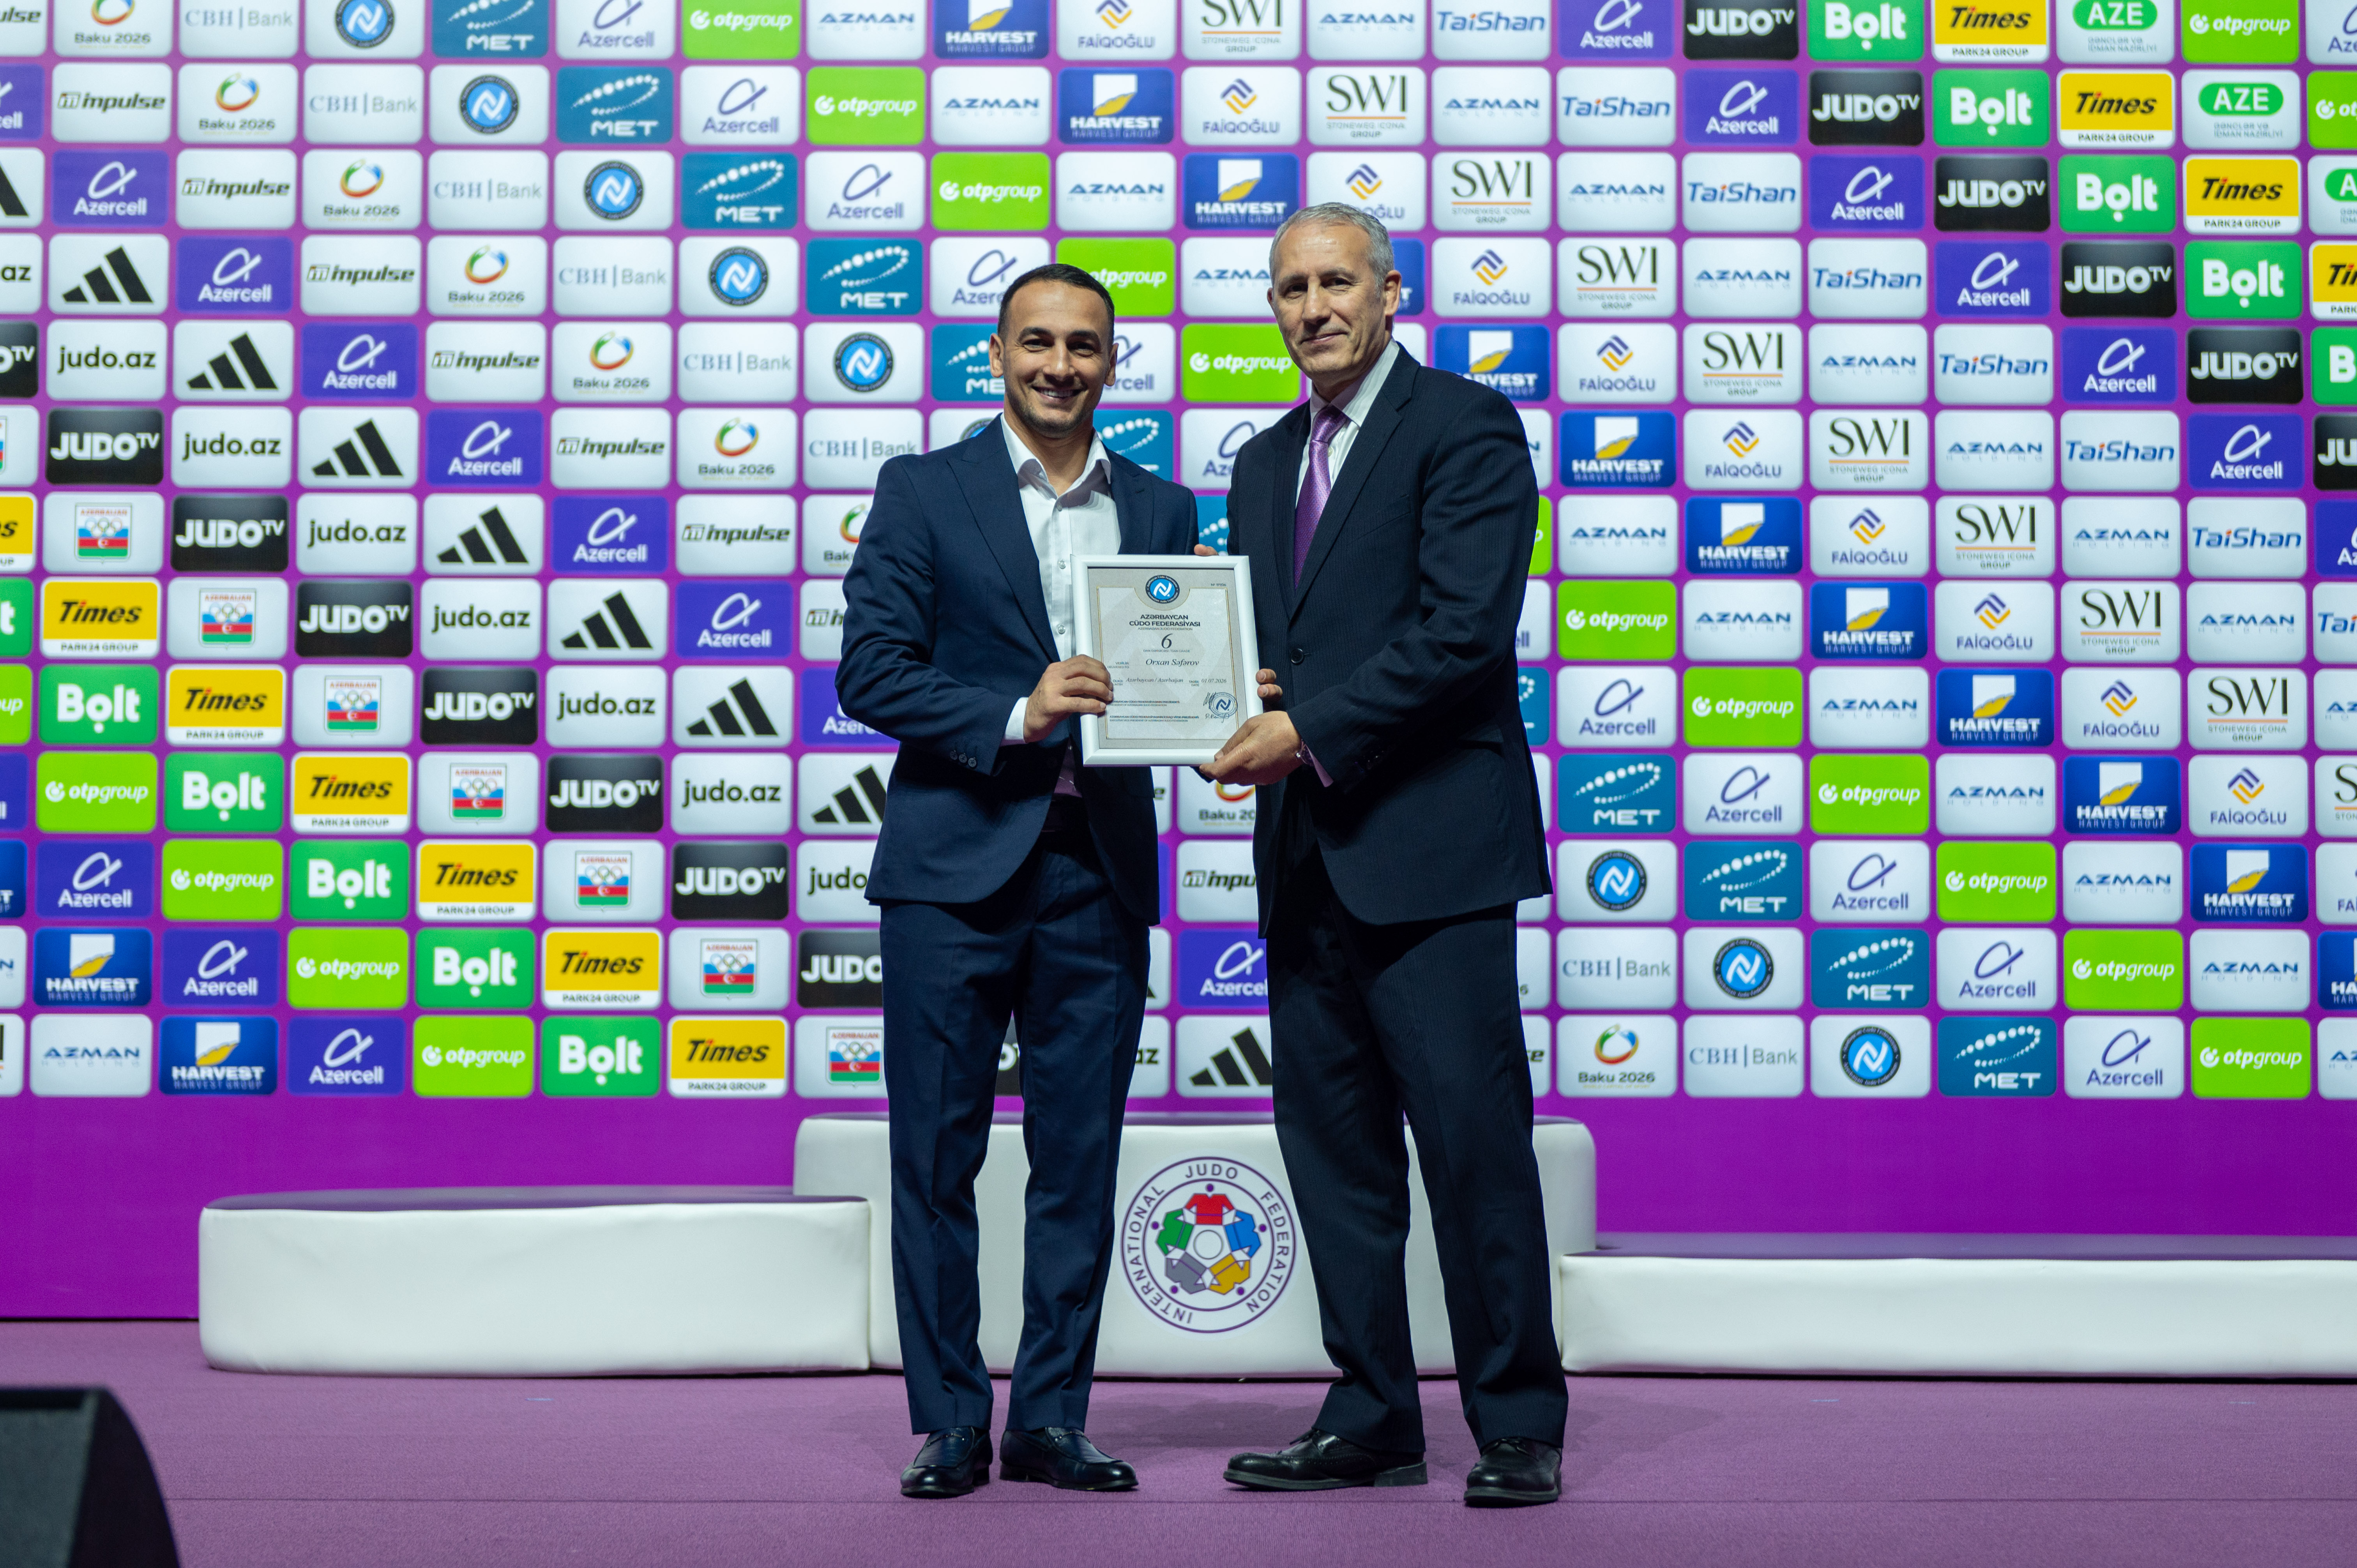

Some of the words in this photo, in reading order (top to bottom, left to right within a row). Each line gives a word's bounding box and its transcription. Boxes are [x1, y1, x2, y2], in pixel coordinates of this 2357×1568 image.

[184, 9, 231, 25] CBH
[248, 9, 292, 25] Bank
[713, 11, 791, 30] otpgroup
[1320, 13, 1413, 23] AZMAN
[1436, 11, 1544, 30] TaiShan
[2212, 15, 2288, 34] otpgroup
[74, 32, 110, 42] Baku
[115, 33, 150, 42] 2026
[466, 34, 534, 49] MET
[577, 30, 654, 46] Azercell
[1580, 30, 1652, 48] Azercell
[82, 93, 166, 112] impulse
[1326, 76, 1406, 112] SWI
[2214, 88, 2268, 111] AZE
[1951, 87, 2031, 135] Bolt
[702, 117, 779, 132] Azercell
[207, 179, 290, 199] impulse
[963, 182, 1041, 201] otpgroup
[1070, 184, 1164, 194] AZMAN
[1688, 183, 1795, 202] TaiShan
[2203, 178, 2282, 200] Times
[716, 207, 783, 222] MET
[331, 266, 415, 285] impulse
[558, 268, 606, 284] CBH
[622, 268, 666, 284] Bank
[1814, 268, 1921, 288] TaiShan
[2203, 260, 2283, 308] Bolt
[449, 292, 484, 302] Baku
[489, 292, 525, 302] 2026
[1957, 288, 2029, 306] Azercell
[57, 346, 155, 374] judo.az
[1822, 357, 1915, 367] AZMAN
[1940, 355, 2046, 374] TaiShan
[323, 370, 397, 388] Azercell
[1829, 419, 1908, 455] SWI
[182, 433, 280, 461] judo.az
[581, 438, 664, 458] impulse
[1572, 460, 1663, 471] HARVEST
[2210, 460, 2282, 479] Azercell
[307, 519, 405, 547] judo.az
[706, 524, 789, 544] impulse
[2193, 527, 2299, 547] TaiShan
[573, 543, 646, 561] Azercell
[60, 601, 142, 623] Times
[2201, 616, 2294, 626] AZMAN
[1161, 633, 1173, 649] 6
[1823, 633, 1915, 644] HARVEST
[1171, 659, 1199, 667] Səfərov
[2208, 678, 2288, 715] SWI
[58, 684, 140, 733] Bolt
[557, 692, 655, 721] judo.az
[1579, 719, 1656, 735] Azercell
[69, 783, 147, 802] otpgroup
[682, 779, 780, 808] judo.az
[1842, 785, 1919, 805] otpgroup
[1950, 787, 2043, 797] AZMAN
[1594, 810, 1660, 825] MET
[1705, 805, 1781, 822] Azercell
[308, 859, 390, 908] Bolt
[58, 888, 132, 907] Azercell
[1720, 897, 1786, 913] MET
[2203, 894, 2295, 905] HARVEST
[2206, 907, 2254, 915] HARVEST
[2257, 907, 2292, 915] GROUP
[320, 959, 398, 978] otpgroup
[561, 951, 643, 973] Times
[2096, 961, 2173, 980] otpgroup
[46, 978, 139, 990] HARVEST
[1958, 980, 2035, 997] Azercell
[49, 991, 97, 999] HARVEST
[101, 991, 136, 999] GROUP
[44, 1048, 139, 1058] AZMAN
[560, 1035, 642, 1085] Bolt
[1689, 1049, 1736, 1065] CBH
[1753, 1049, 1797, 1065] Bank
[309, 1065, 383, 1084] Azercell
[1578, 1073, 1614, 1083] Baku
[1618, 1073, 1654, 1082] 2026
[1974, 1073, 2041, 1089] MET
[2086, 1069, 2163, 1086] Azercell
[1127, 1186, 1193, 1324] INTERNATIONAL
[1185, 1164, 1238, 1180] JUDO
[1245, 1191, 1290, 1313] FEDERATION
